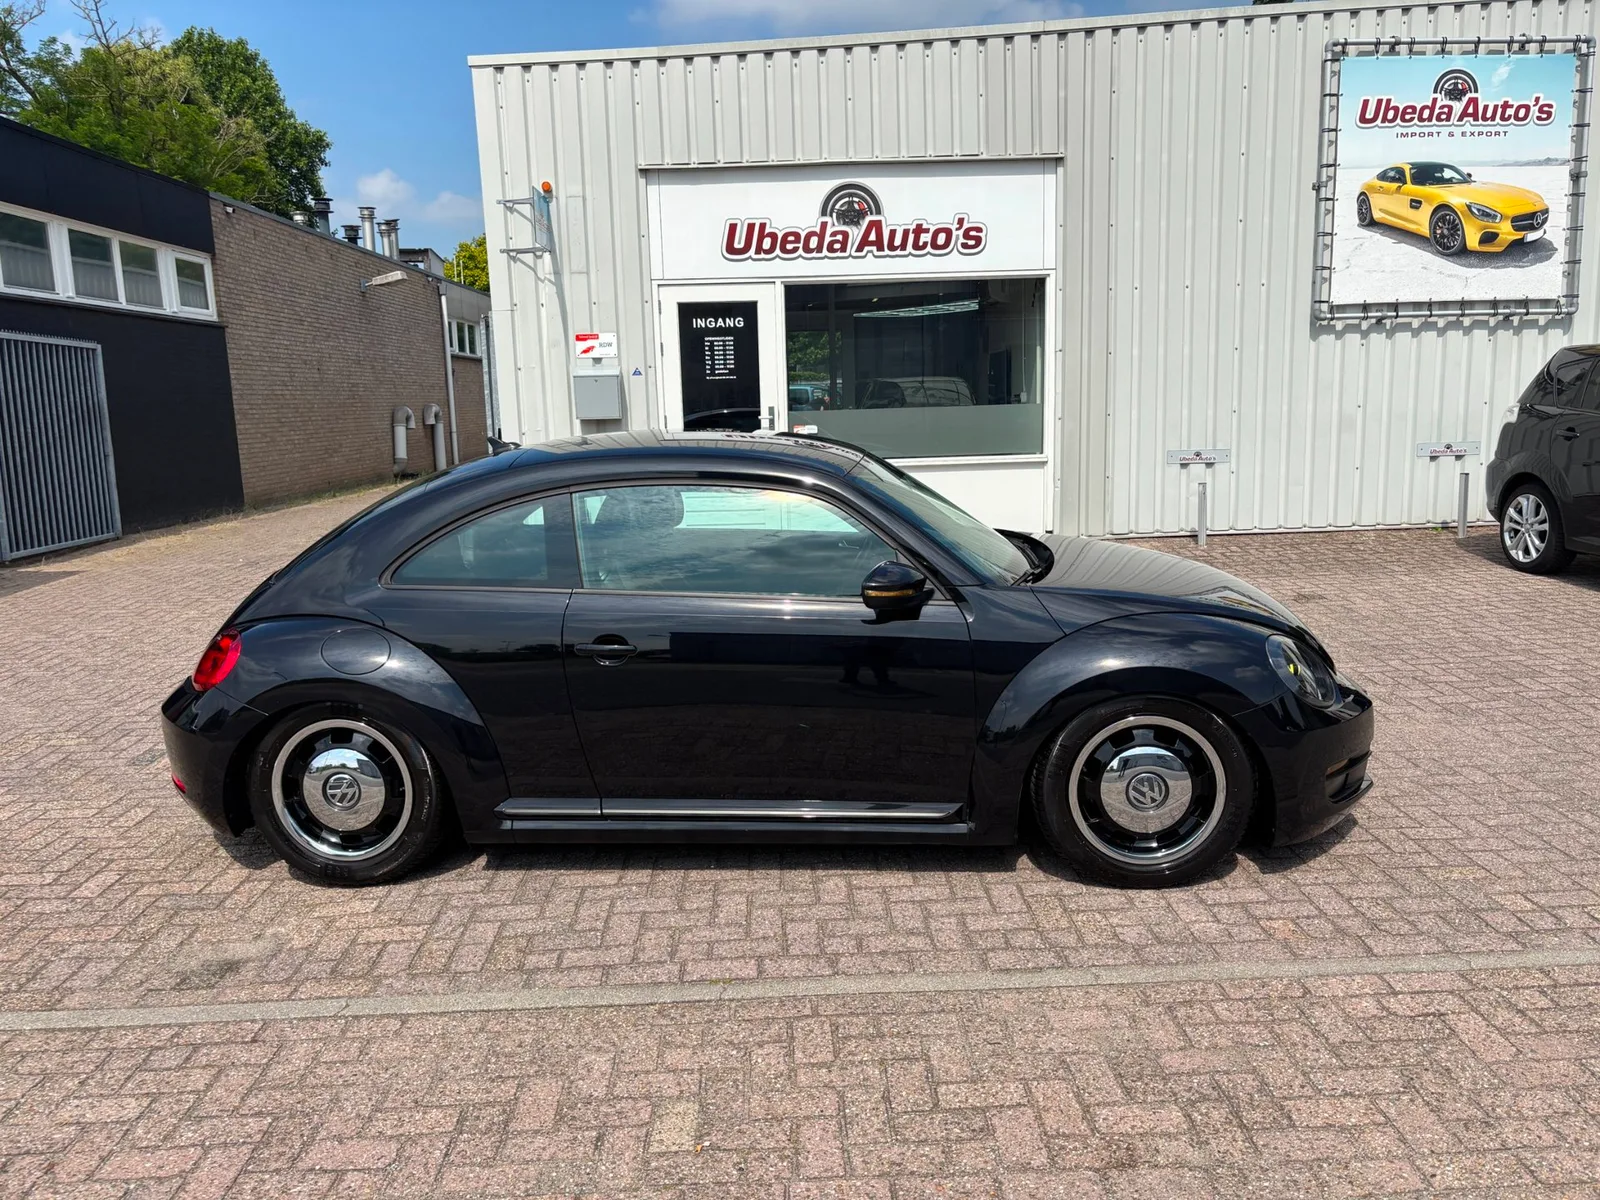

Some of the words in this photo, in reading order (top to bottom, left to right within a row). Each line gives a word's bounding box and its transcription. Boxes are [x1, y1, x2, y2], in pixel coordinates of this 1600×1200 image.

[1358, 96, 1454, 125] Ubeda
[1456, 95, 1554, 123] Auto's
[1396, 131, 1442, 139] IMPORT
[1461, 130, 1509, 138] EXPORT
[725, 220, 850, 256] Ubeda
[854, 216, 983, 253] Auto's
[692, 317, 745, 329] INGANG
